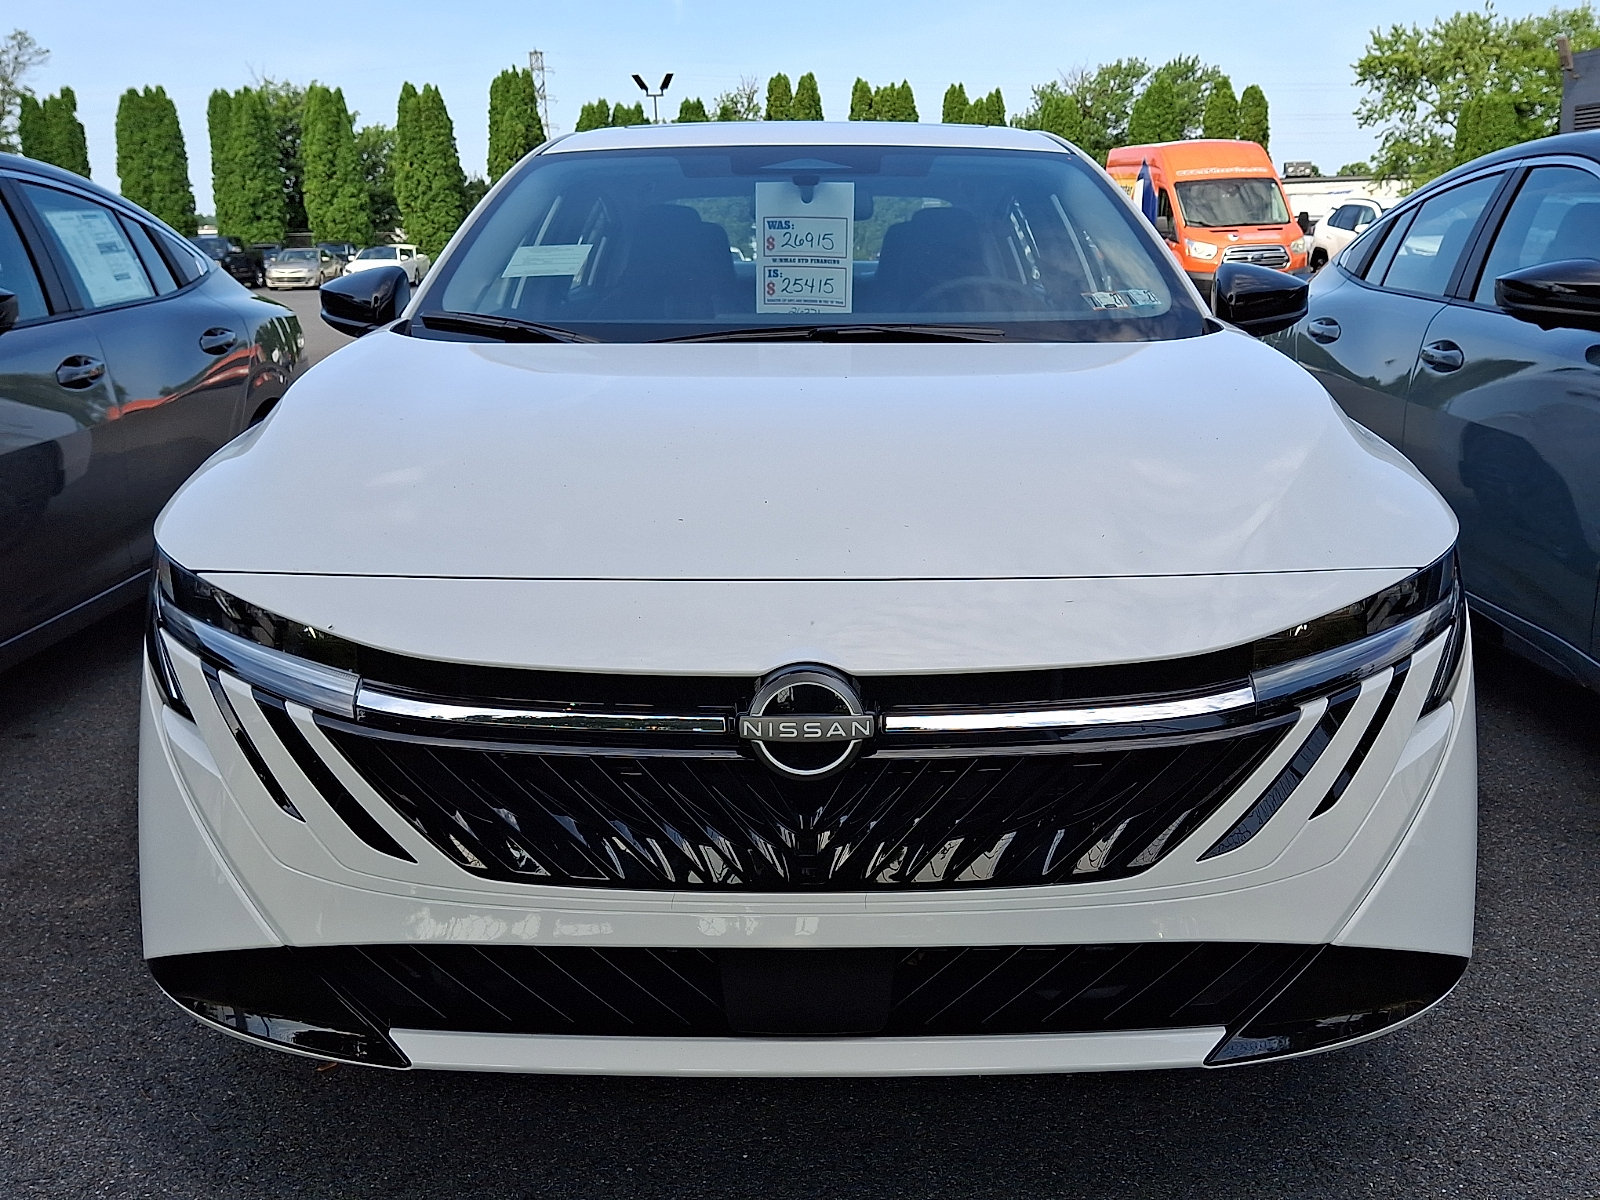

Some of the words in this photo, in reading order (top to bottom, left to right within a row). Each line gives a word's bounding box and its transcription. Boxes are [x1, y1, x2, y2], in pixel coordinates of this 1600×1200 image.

[766, 220, 795, 230] WAS:
[766, 235, 775, 251] $
[767, 269, 783, 278] IS:
[766, 281, 775, 296] $
[781, 277, 835, 294] 25415
[743, 720, 870, 738] NISSAN
